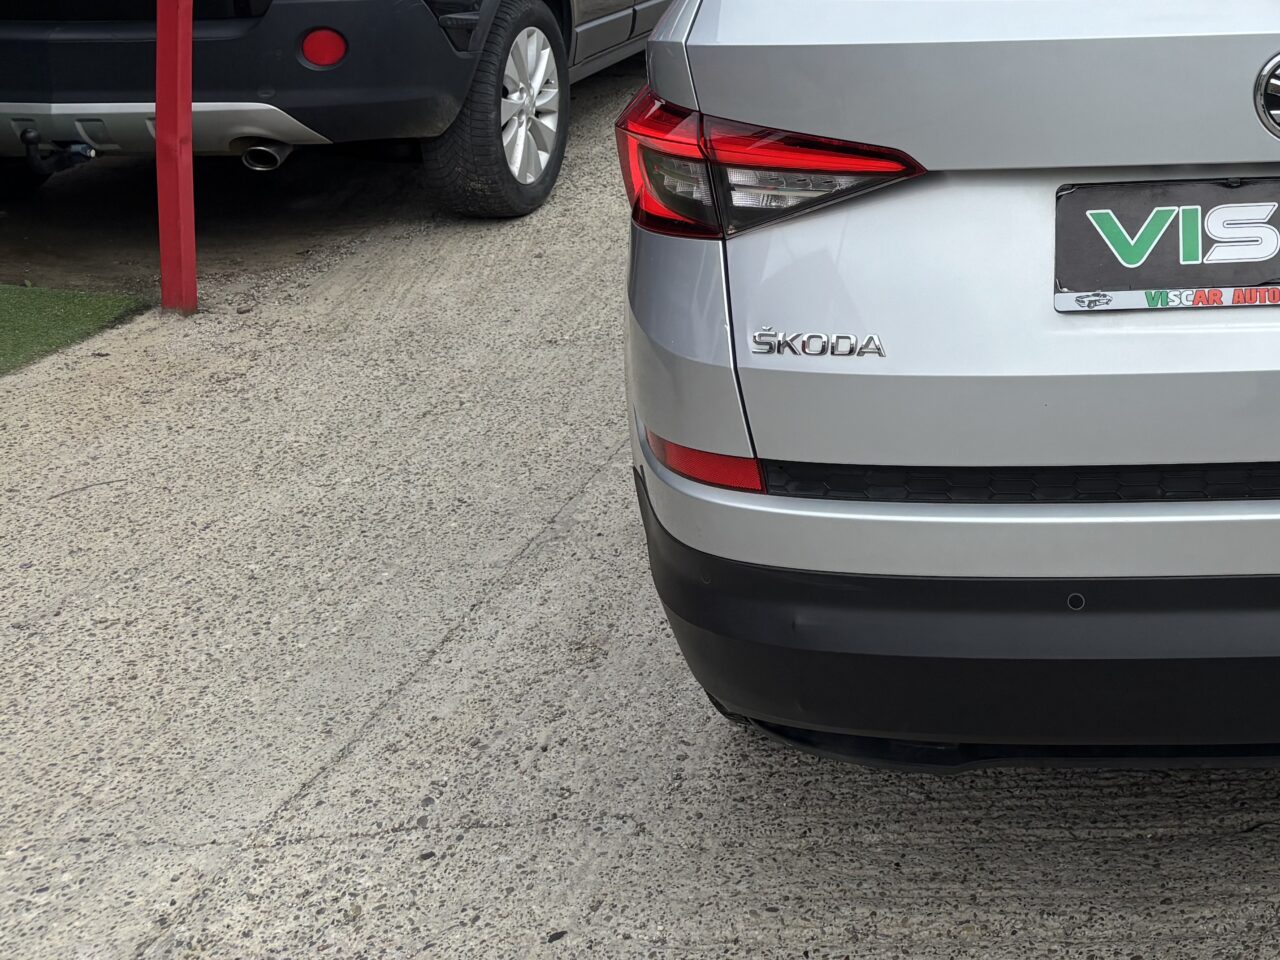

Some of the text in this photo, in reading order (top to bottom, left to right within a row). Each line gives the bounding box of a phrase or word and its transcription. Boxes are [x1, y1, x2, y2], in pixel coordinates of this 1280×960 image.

[1145, 289, 1223, 307] VISCAR
[1232, 288, 1280, 305] AUTO
[752, 326, 886, 357] ŠKODA
